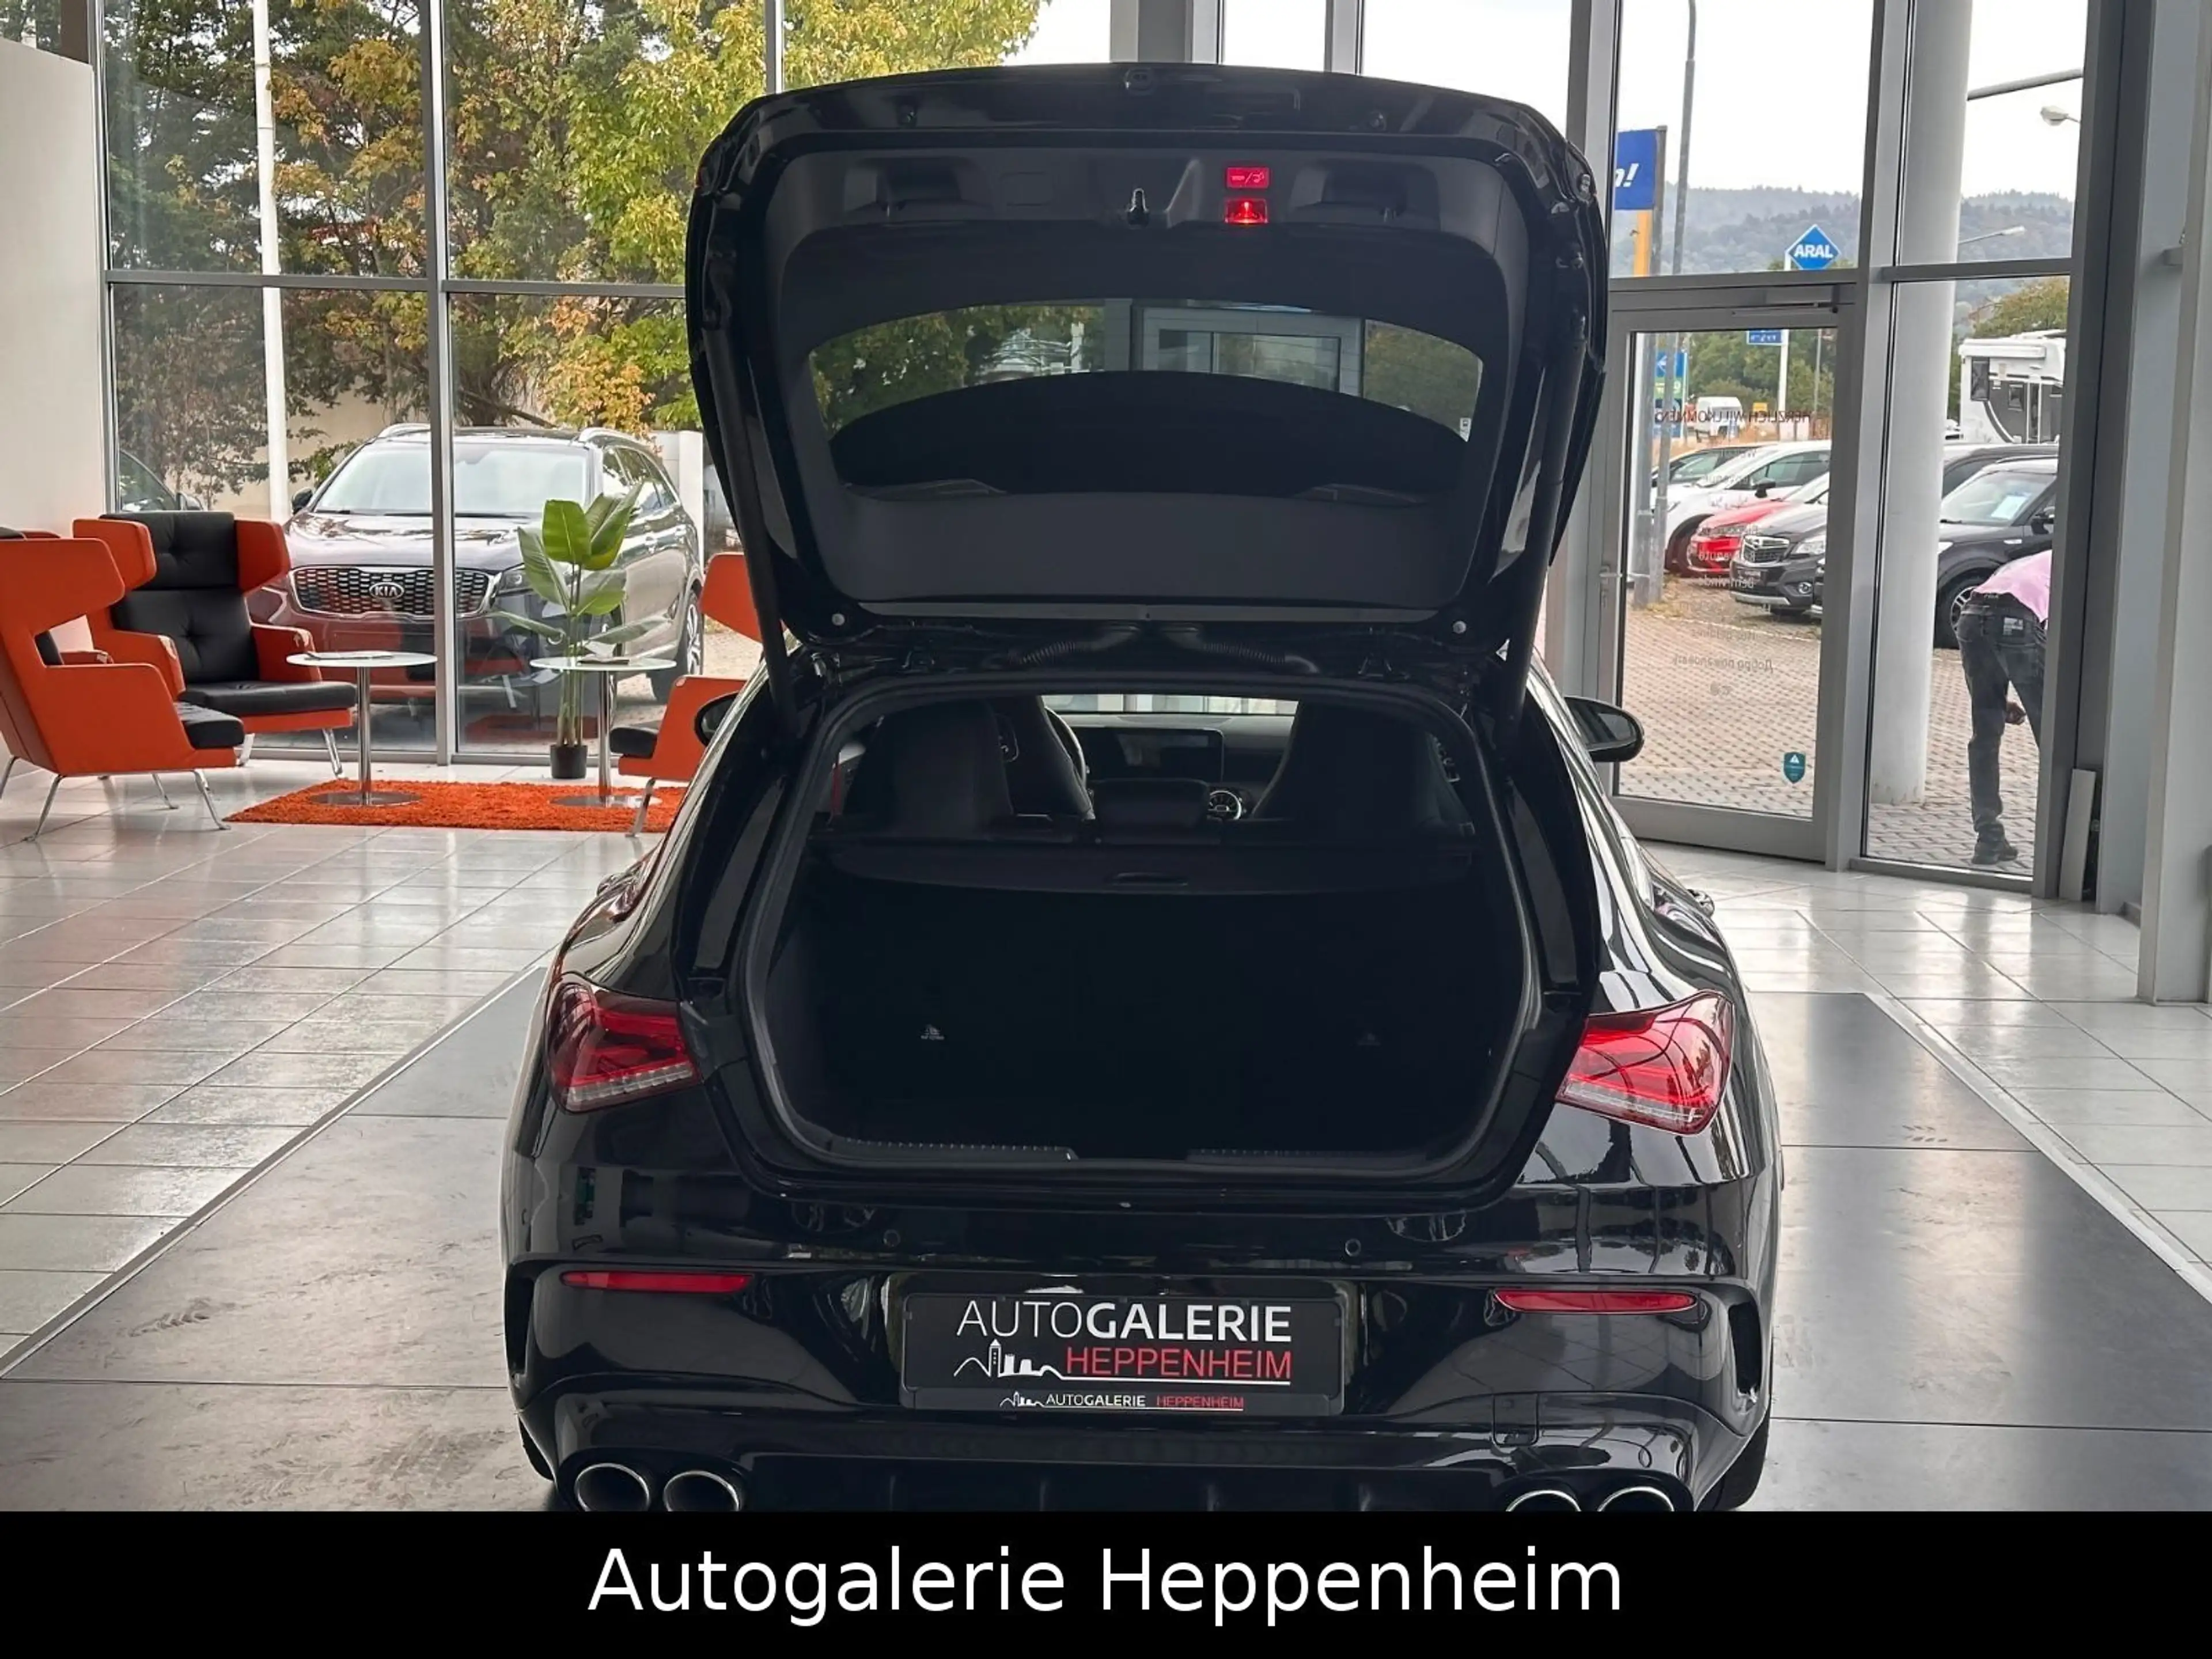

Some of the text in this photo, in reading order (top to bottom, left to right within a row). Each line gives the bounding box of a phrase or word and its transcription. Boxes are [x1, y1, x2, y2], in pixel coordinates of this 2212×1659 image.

[1793, 244, 1834, 258] ARAL
[374, 586, 397, 597] KIA
[956, 1300, 1292, 1343] AUTOGALERIE
[1066, 1346, 1291, 1378] HEPPENHEIM
[1046, 1393, 1244, 1410] AUTOGALERIE HEPPENHEIM
